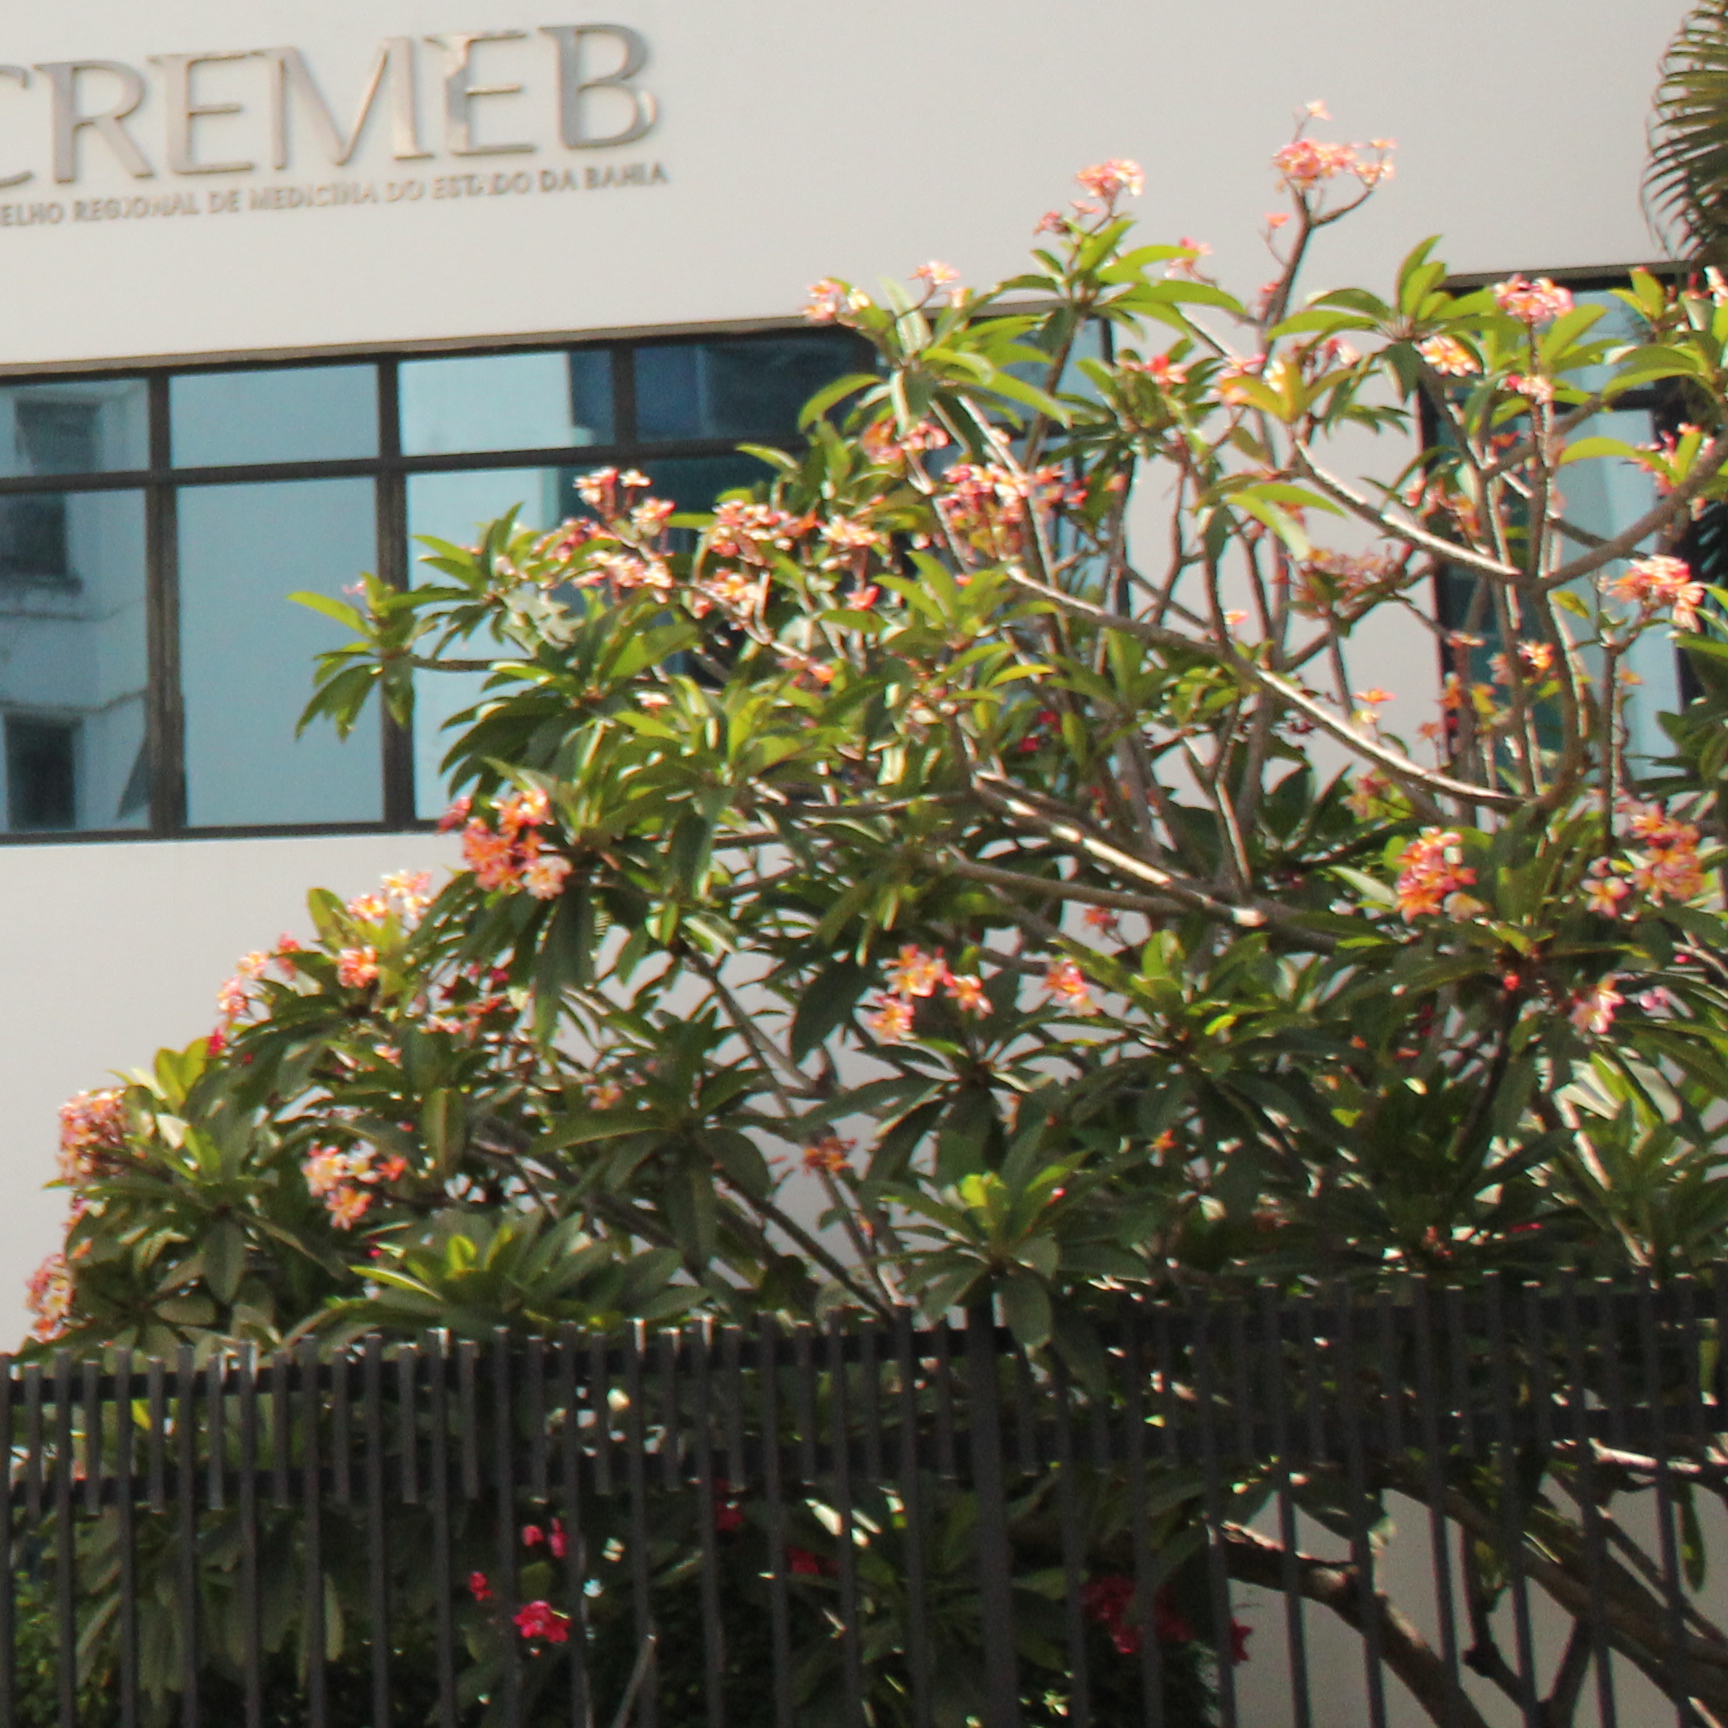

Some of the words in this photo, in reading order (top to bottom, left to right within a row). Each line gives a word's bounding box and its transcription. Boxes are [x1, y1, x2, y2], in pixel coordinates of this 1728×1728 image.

[72, 192, 199, 222] REGIONAL
[208, 188, 240, 214] DE
[248, 180, 377, 211] MEDICINA
[385, 178, 425, 203] DO
[539, 166, 576, 193] DA
[583, 160, 669, 191] BAHIA
